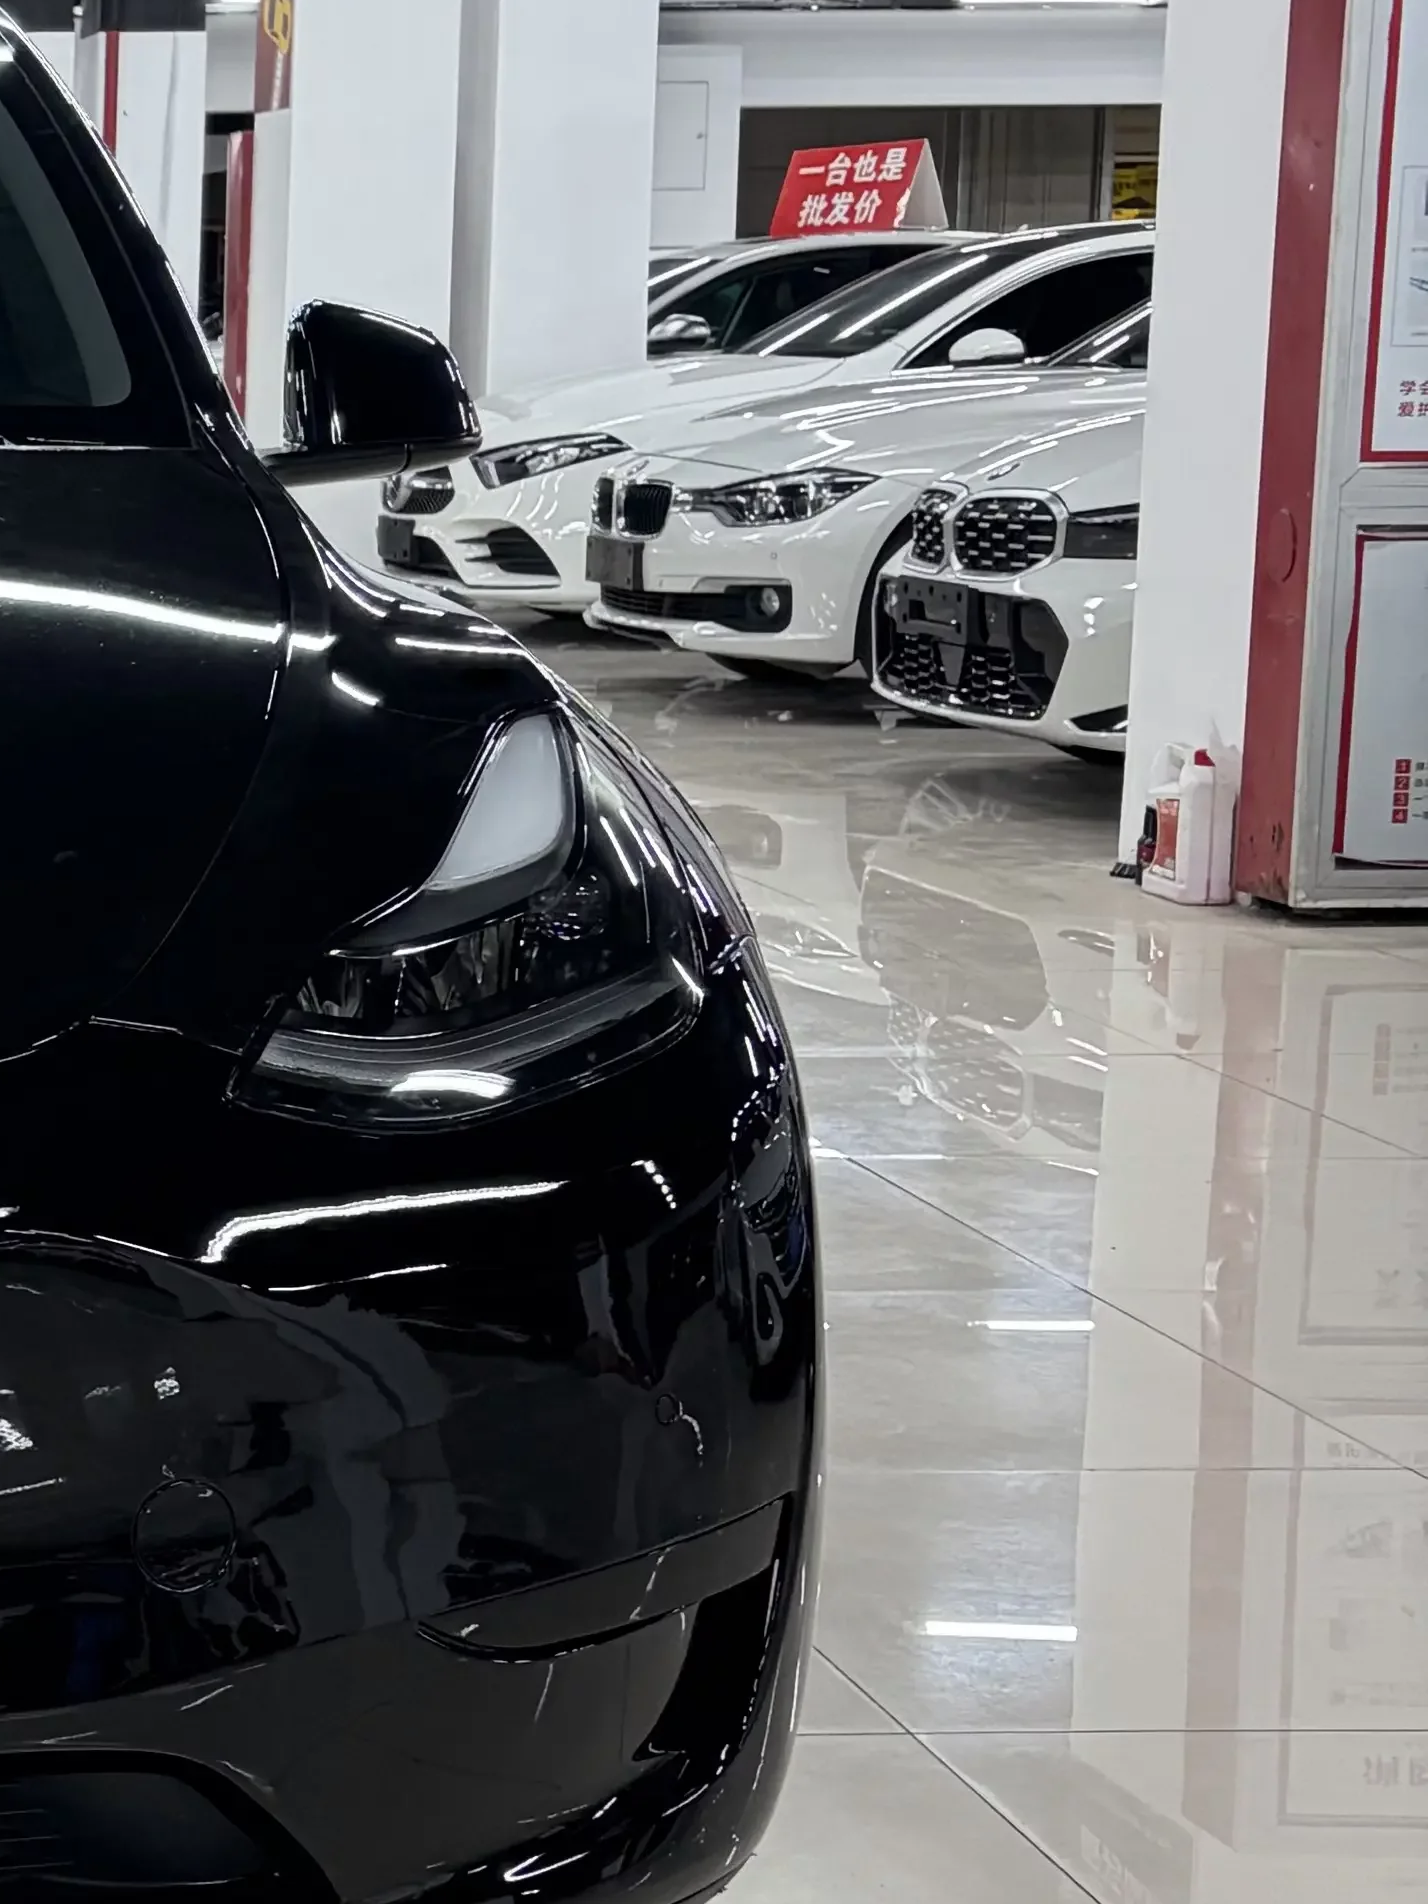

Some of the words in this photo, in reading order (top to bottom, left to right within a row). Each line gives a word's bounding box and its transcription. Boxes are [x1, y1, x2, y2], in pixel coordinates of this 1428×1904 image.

[799, 147, 907, 187] 一台也是
[797, 189, 883, 228] 批发价
